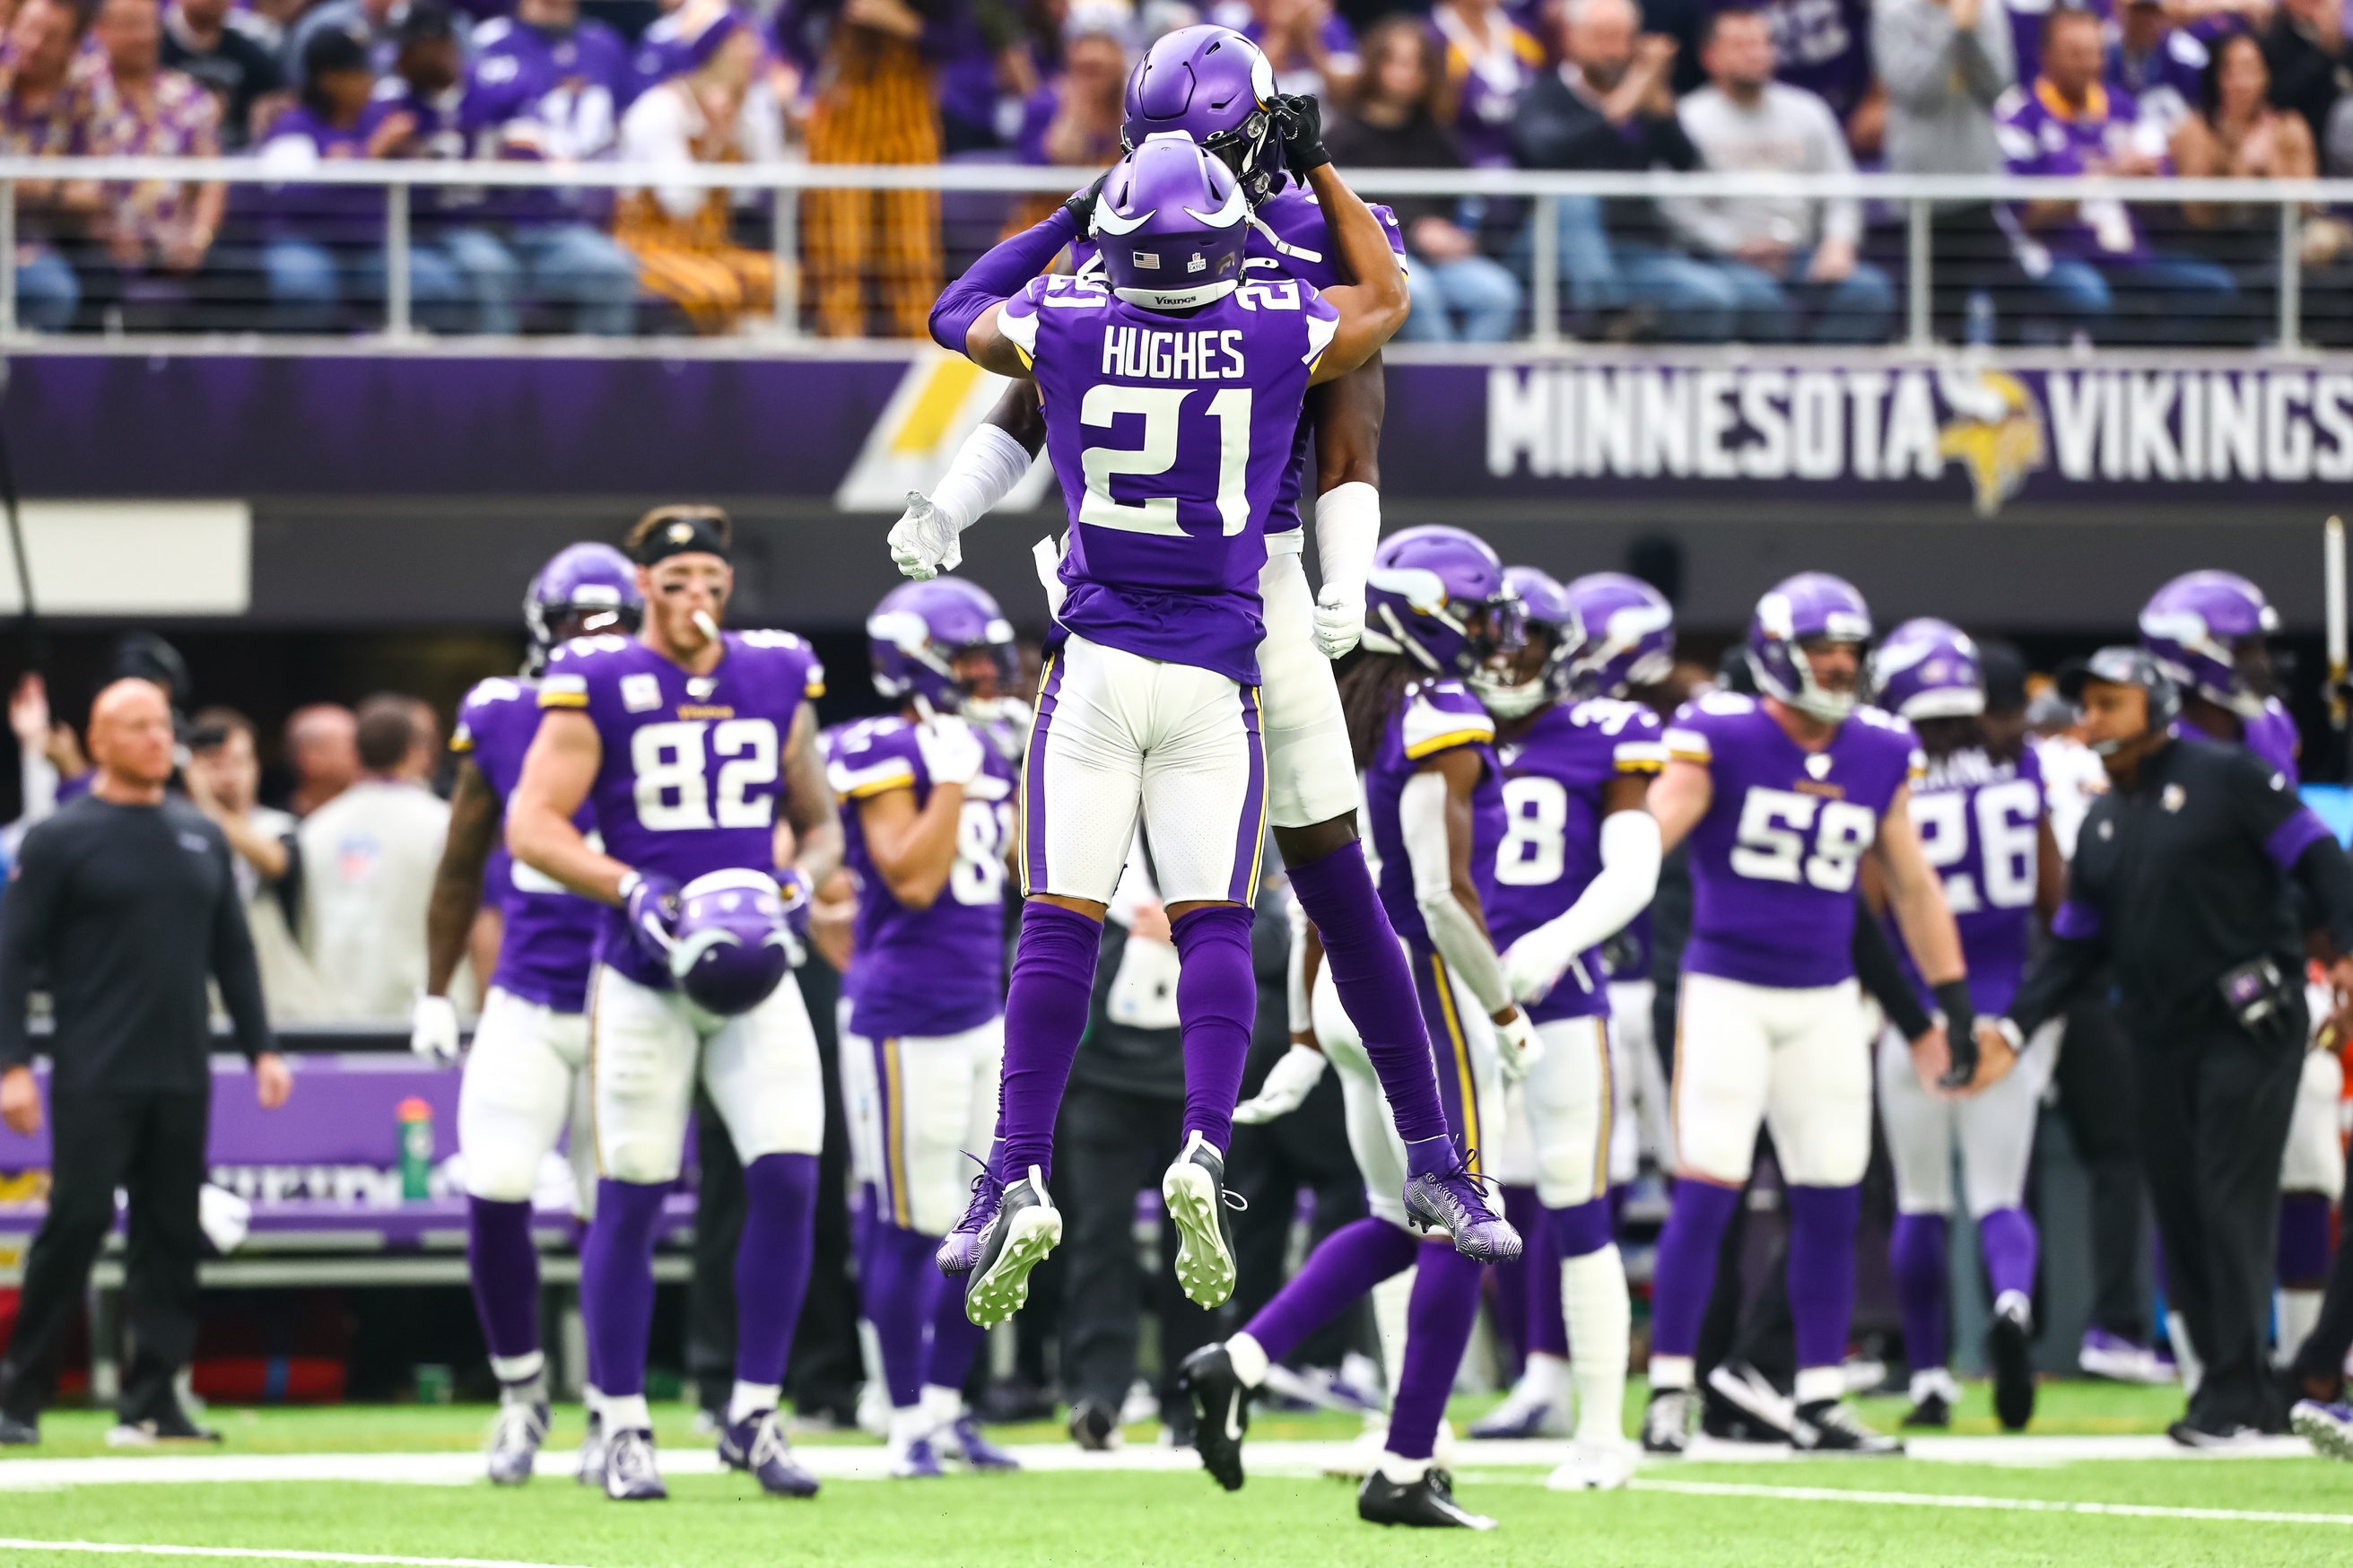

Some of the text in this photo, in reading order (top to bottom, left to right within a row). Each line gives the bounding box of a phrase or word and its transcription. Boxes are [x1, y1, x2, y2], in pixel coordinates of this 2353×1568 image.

[1102, 325, 1245, 379] HUGHES
[1078, 384, 1252, 537] 21
[1486, 368, 2353, 482] MINNESOTA VIKINGS
[631, 718, 779, 831] 82
